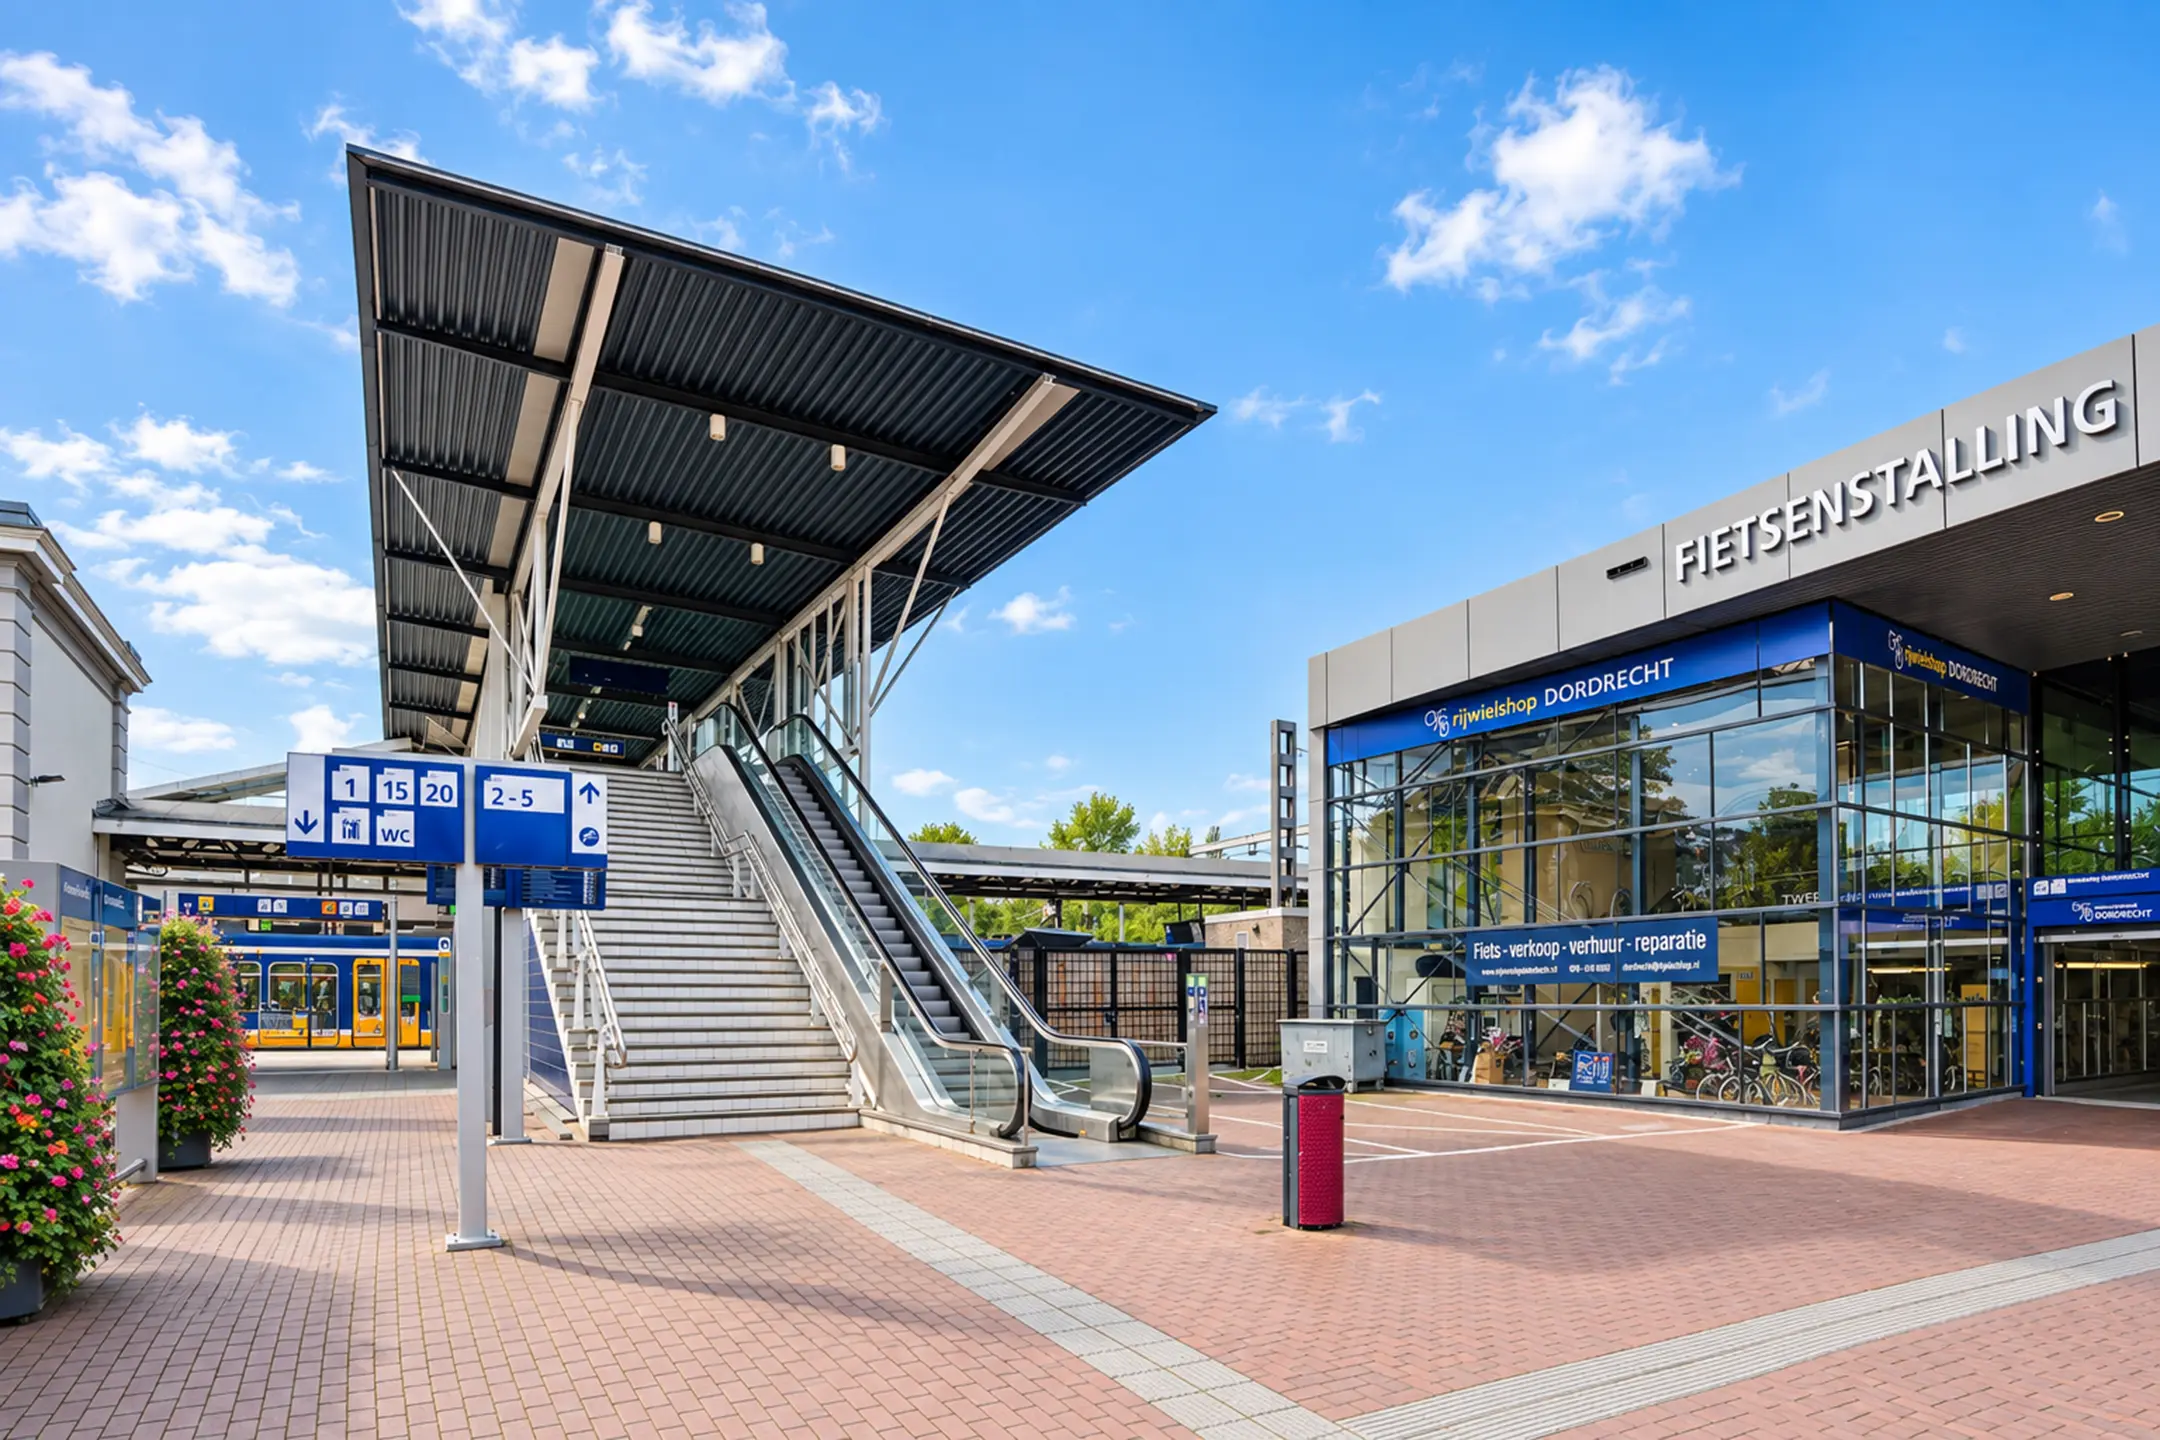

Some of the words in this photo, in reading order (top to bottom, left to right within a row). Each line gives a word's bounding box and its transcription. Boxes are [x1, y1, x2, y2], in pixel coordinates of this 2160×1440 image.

[1675, 378, 2119, 583] FIETSENSTALLING
[1452, 696, 1538, 730] rijwielshop
[1544, 658, 1674, 707] DORDRECHT
[345, 778, 355, 798] 1
[383, 780, 408, 800] 15
[425, 783, 453, 803] 20
[381, 828, 410, 843] WC
[1473, 942, 1501, 960] Fiets
[1509, 939, 1560, 960] verkoop
[1569, 935, 1625, 956] verhuur
[1634, 929, 1707, 955] reparatie
